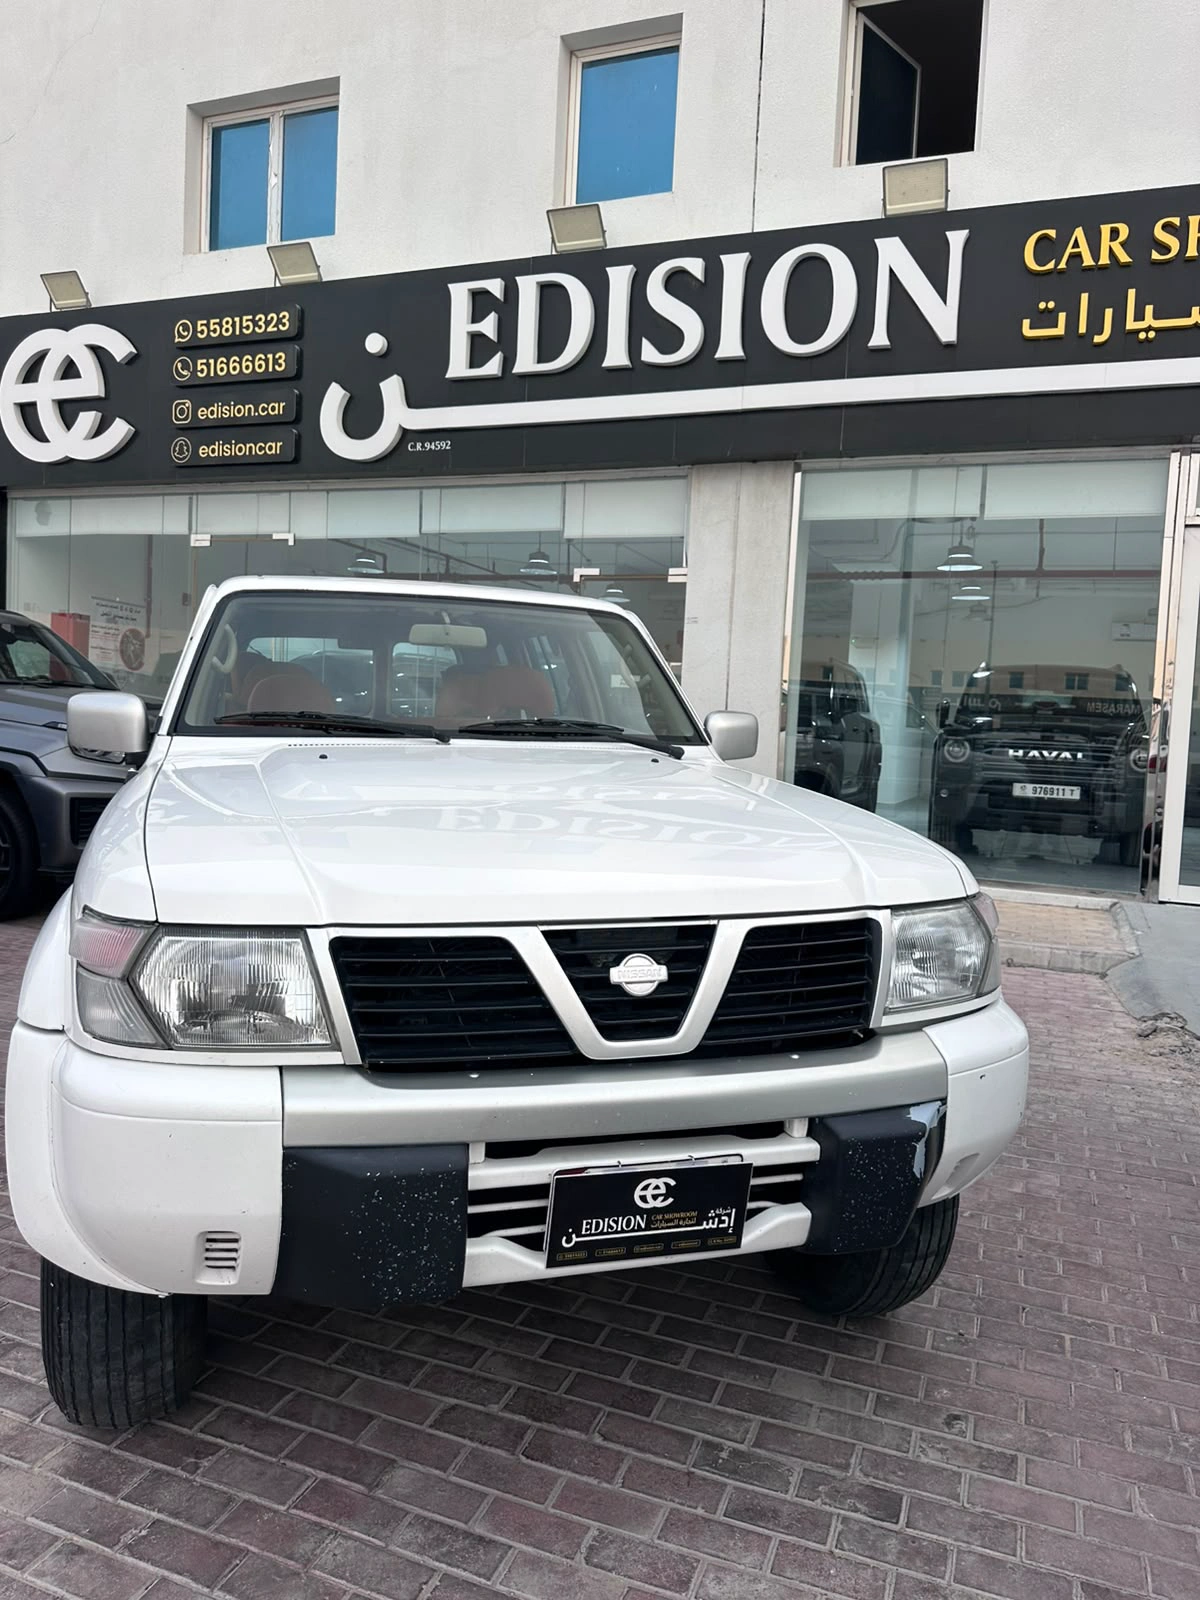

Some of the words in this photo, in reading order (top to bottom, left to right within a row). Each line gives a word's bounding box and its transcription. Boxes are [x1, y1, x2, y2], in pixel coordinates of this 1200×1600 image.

[1023, 222, 1133, 274] CAR
[445, 229, 969, 381] EDISION
[196, 311, 290, 339] 55815323
[196, 352, 286, 378] 51666613
[197, 401, 286, 420] edision.car
[198, 440, 283, 458] edisioncar
[408, 440, 451, 451] C.R.94592
[1008, 748, 1087, 762] HAVAL
[1031, 785, 1066, 797] 976911
[617, 966, 662, 980] NISSAN
[581, 1214, 647, 1235] EDISION
